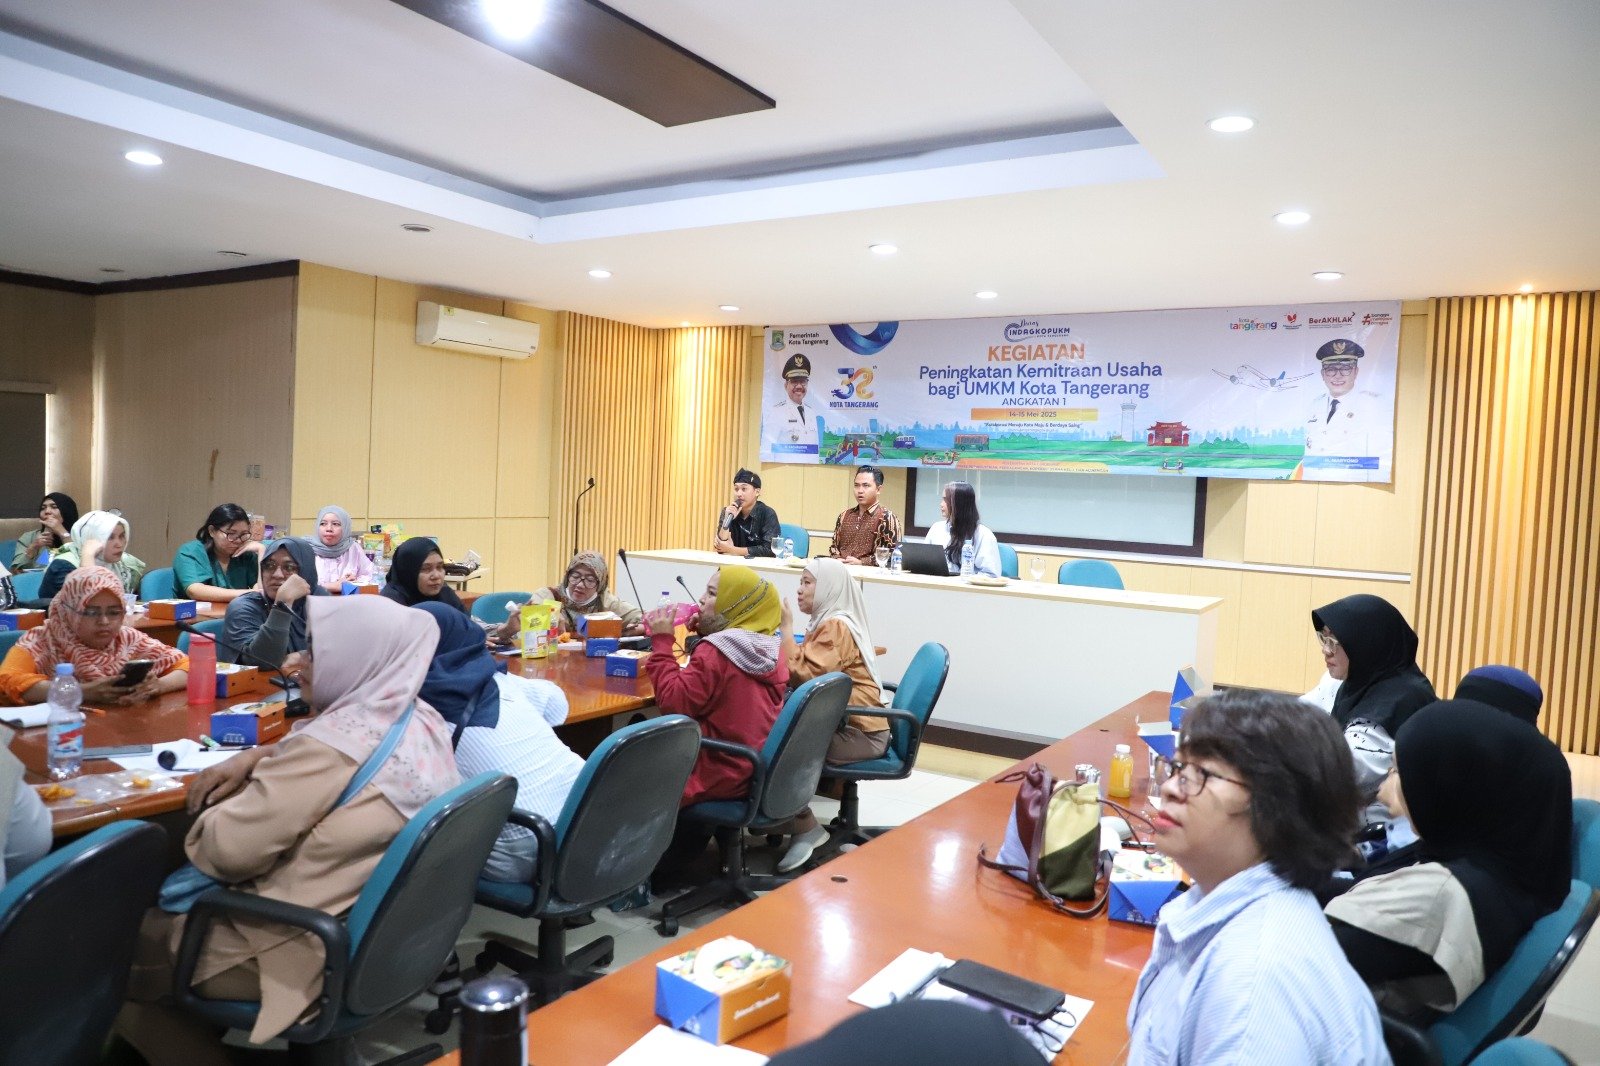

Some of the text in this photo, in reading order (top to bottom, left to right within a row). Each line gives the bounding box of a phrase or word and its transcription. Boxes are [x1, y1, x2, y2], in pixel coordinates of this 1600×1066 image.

[1308, 316, 1353, 324] BerAKHLAK
[1229, 322, 1278, 331] tangerang
[1009, 327, 1071, 336] INDAGKOPUKM
[987, 342, 1085, 362] KEGIATAN
[919, 361, 1163, 383] Peningkatan Kemitraan Usaha
[928, 380, 1150, 400] bagi UMKM Kota Tangerang
[1001, 397, 1060, 406] ANGKATAN
